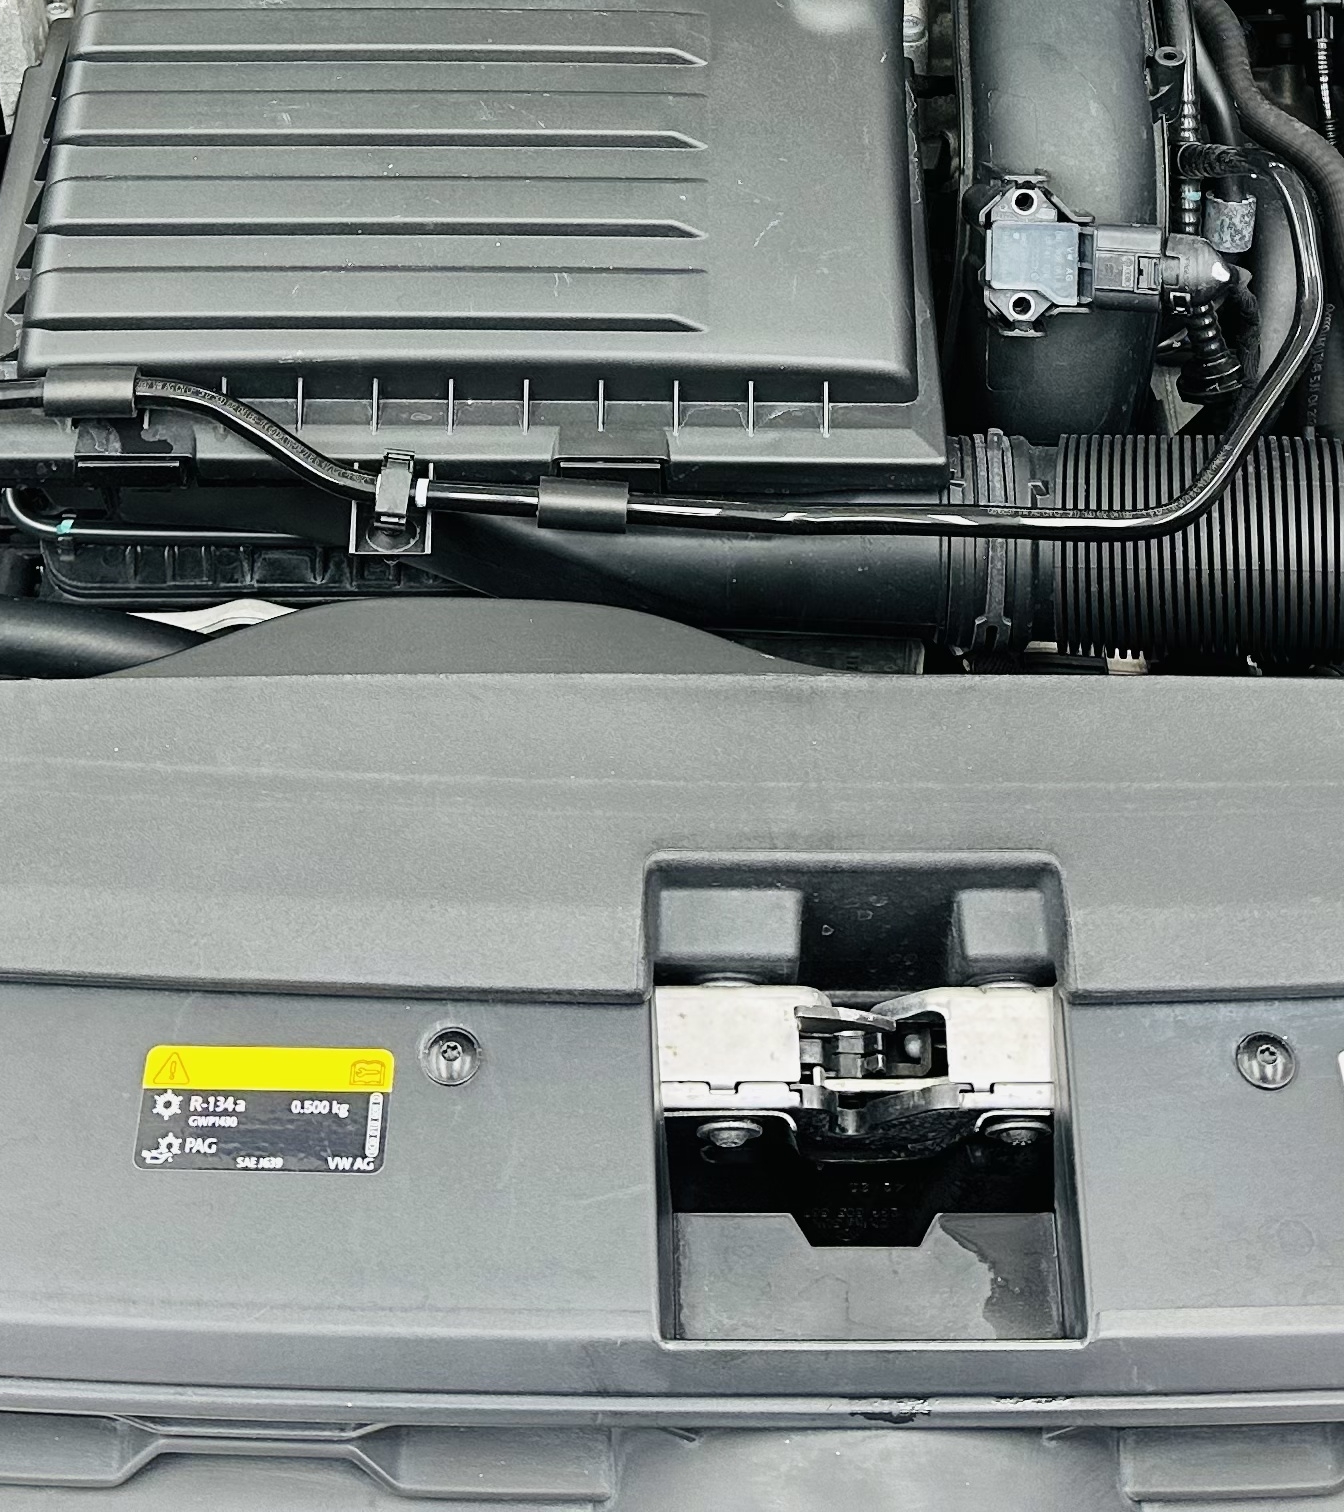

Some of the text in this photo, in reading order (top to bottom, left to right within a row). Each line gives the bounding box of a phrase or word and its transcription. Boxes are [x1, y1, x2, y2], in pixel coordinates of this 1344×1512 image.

[1065, 267, 1073, 282] AG
[189, 1096, 349, 1117] R-134a 0.500 kg
[184, 1138, 217, 1153] PAG
[236, 1157, 258, 1168] SAE
[327, 1157, 352, 1169] VW
[353, 1157, 375, 1170] AG
